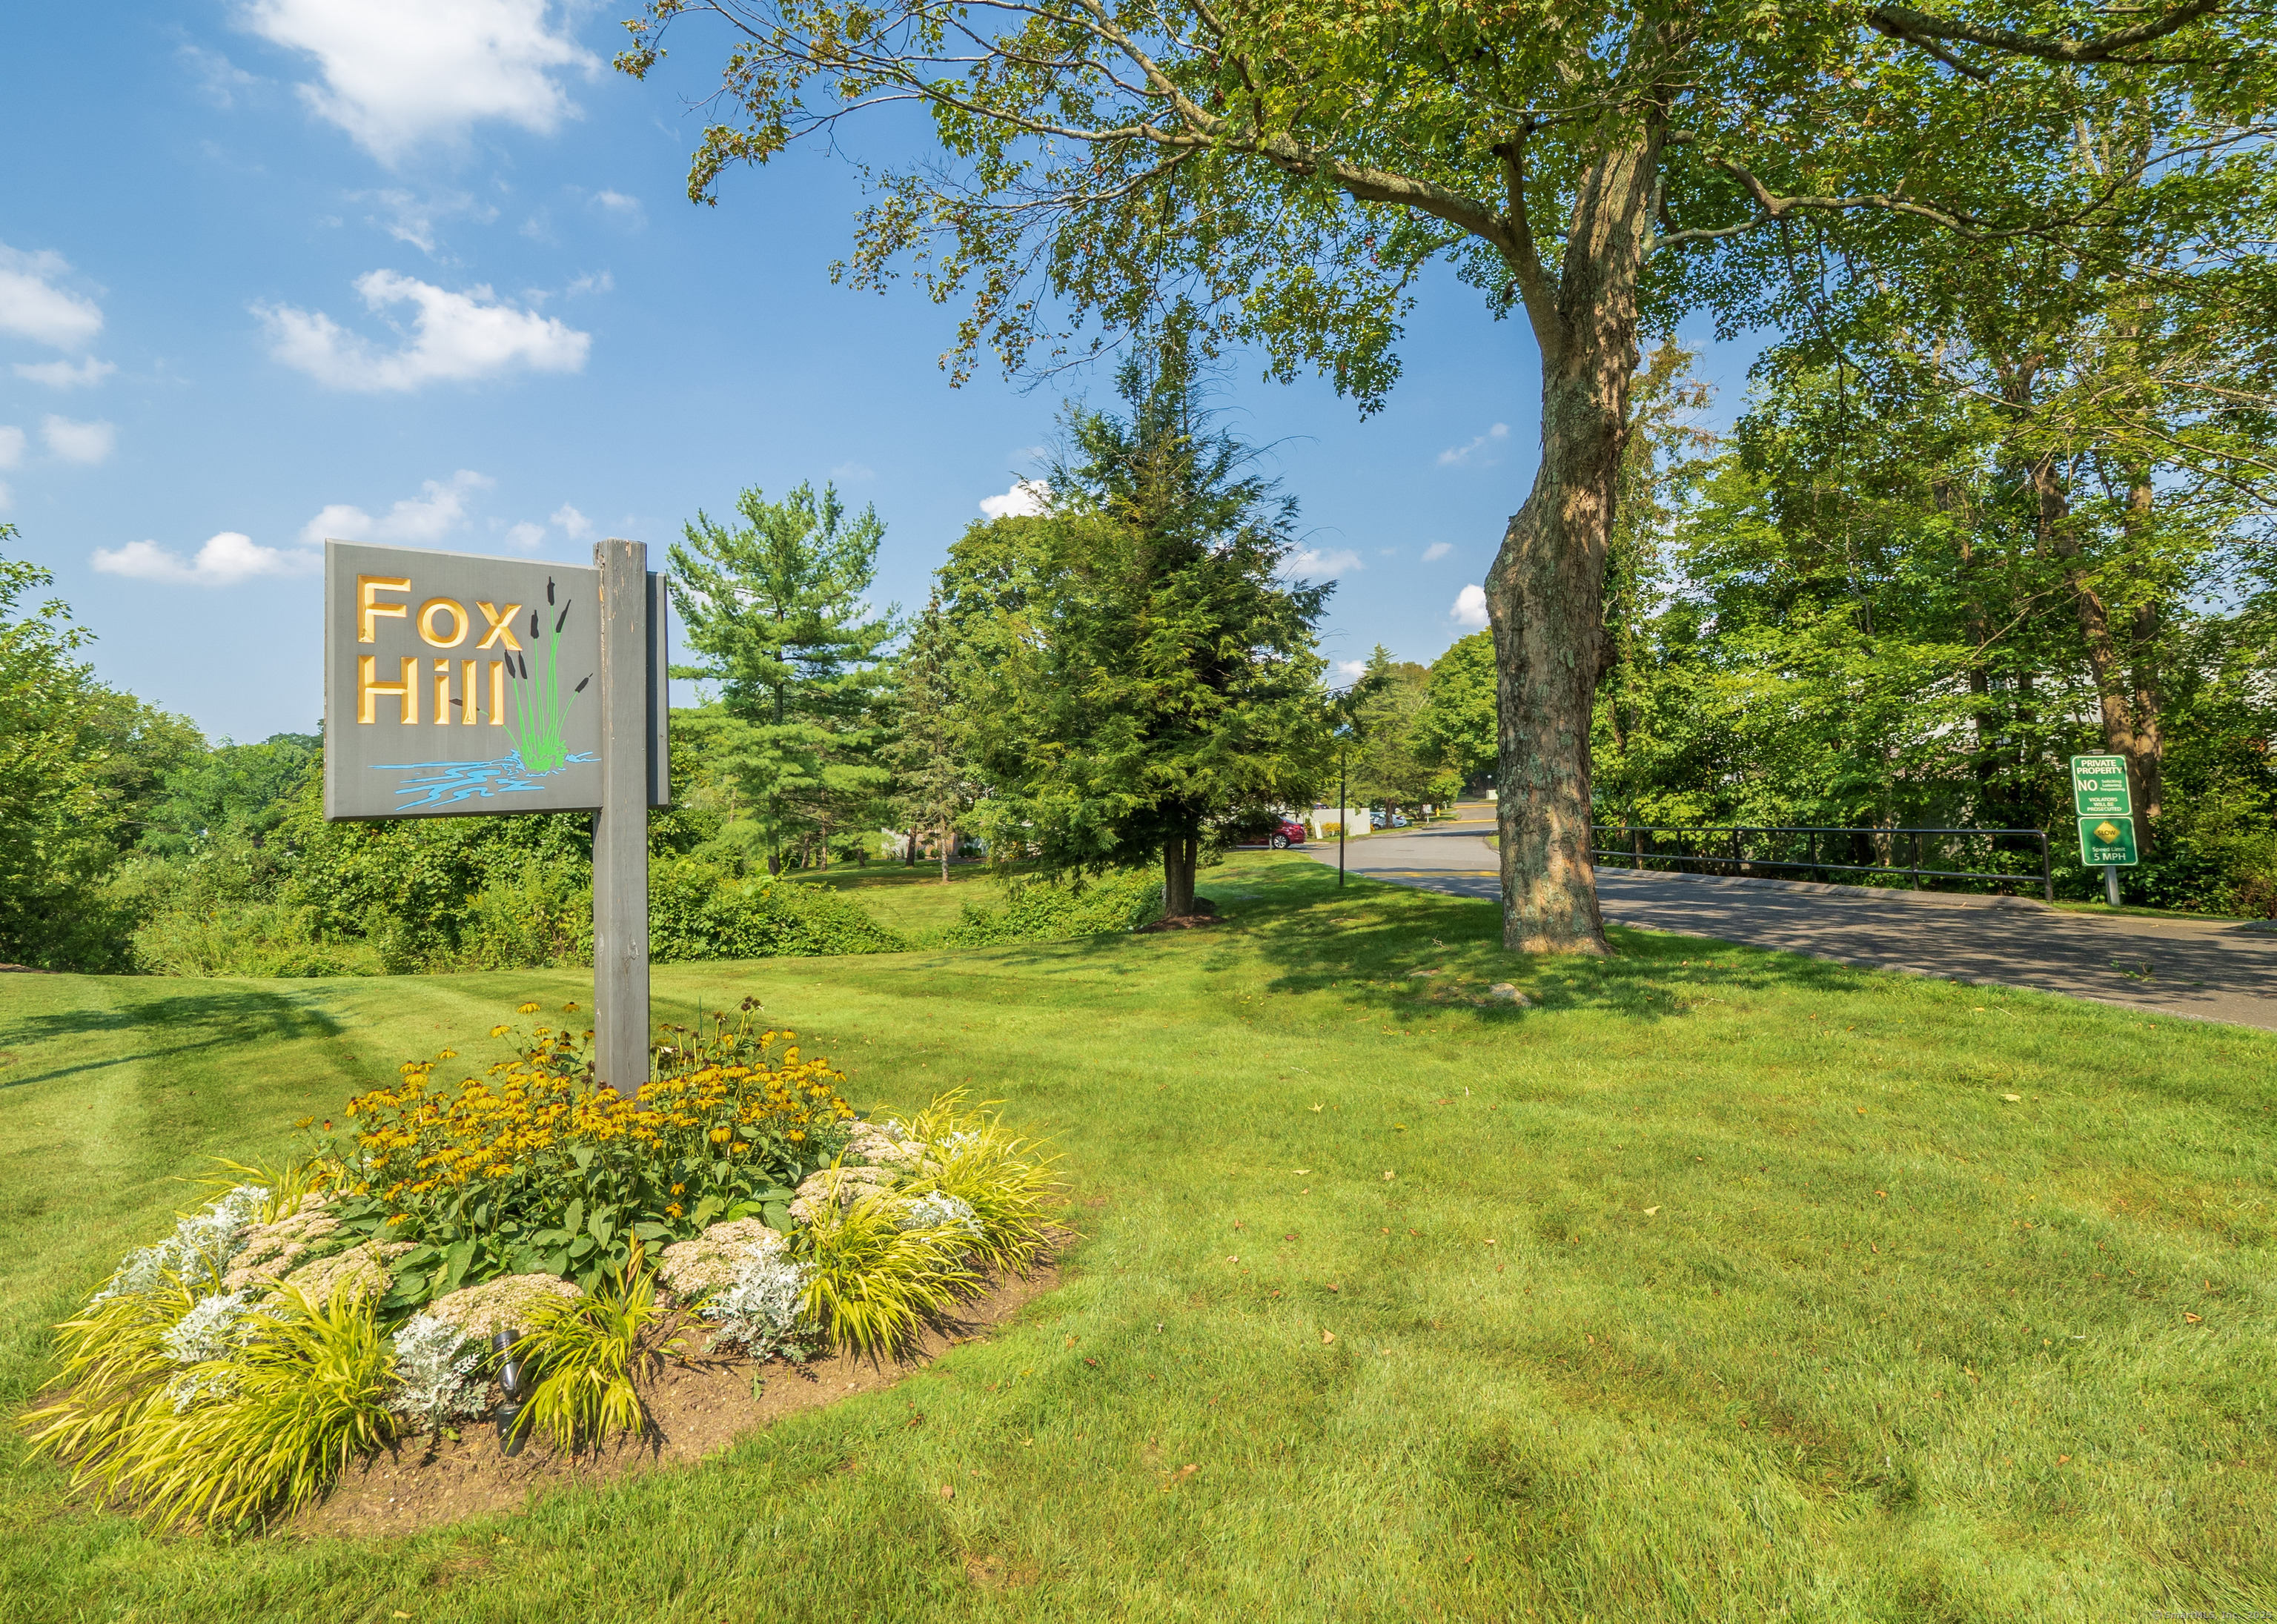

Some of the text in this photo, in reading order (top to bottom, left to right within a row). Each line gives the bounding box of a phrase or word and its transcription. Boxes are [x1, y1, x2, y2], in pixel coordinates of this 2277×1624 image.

[357, 574, 523, 651] Fox
[357, 654, 505, 726] Hill
[2078, 780, 2098, 791] NO
[2102, 852, 2127, 861] MPH
